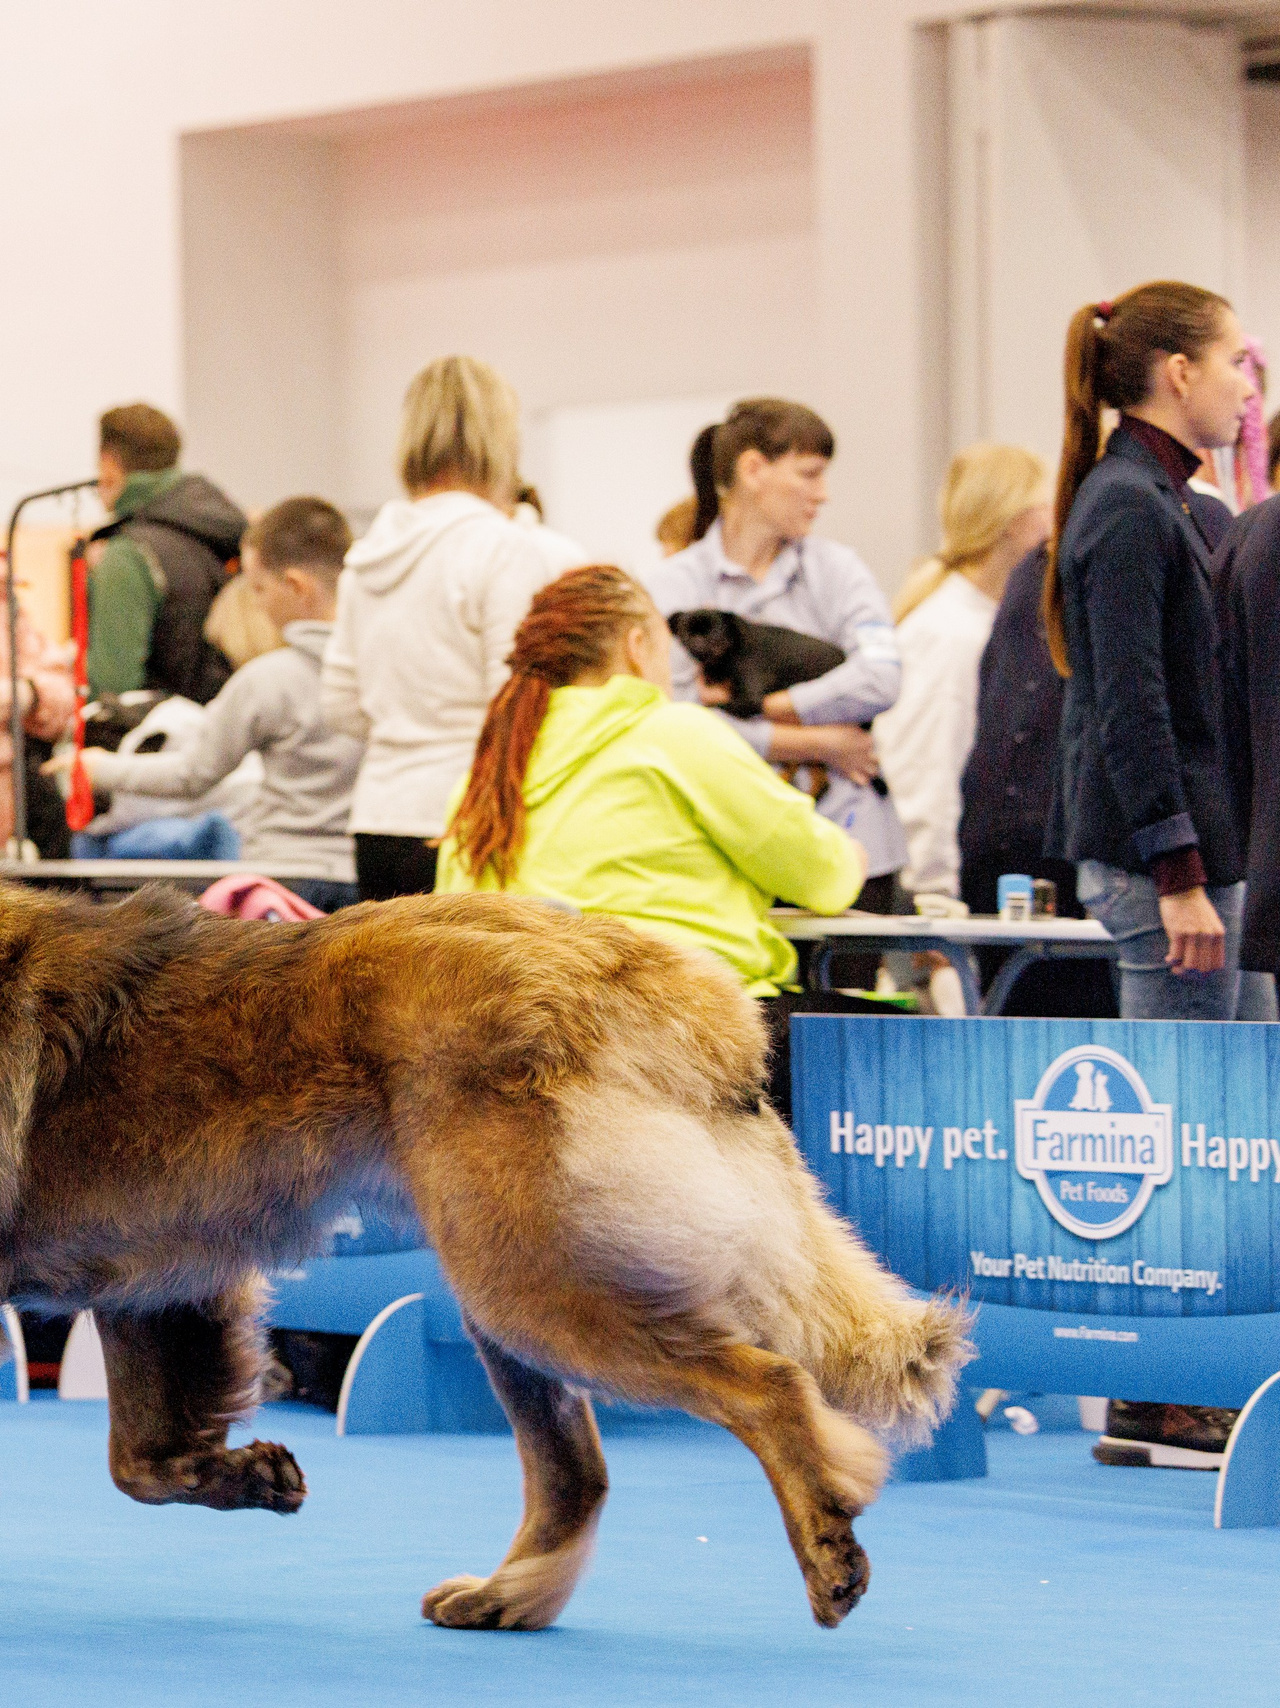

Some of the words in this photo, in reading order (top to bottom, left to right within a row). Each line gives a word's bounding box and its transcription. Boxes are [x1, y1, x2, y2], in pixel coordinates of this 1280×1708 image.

[830, 1110, 934, 1168] Happy
[943, 1119, 1008, 1170] pet.
[1032, 1118, 1156, 1165] Farmina
[1181, 1122, 1280, 1184] Happy
[1059, 1180, 1085, 1201] Pet
[1086, 1181, 1129, 1204] Foods
[970, 1250, 1013, 1277] Your
[1014, 1253, 1045, 1280] Pet
[1047, 1255, 1130, 1284] Nutrition
[1132, 1259, 1223, 1296] Company.
